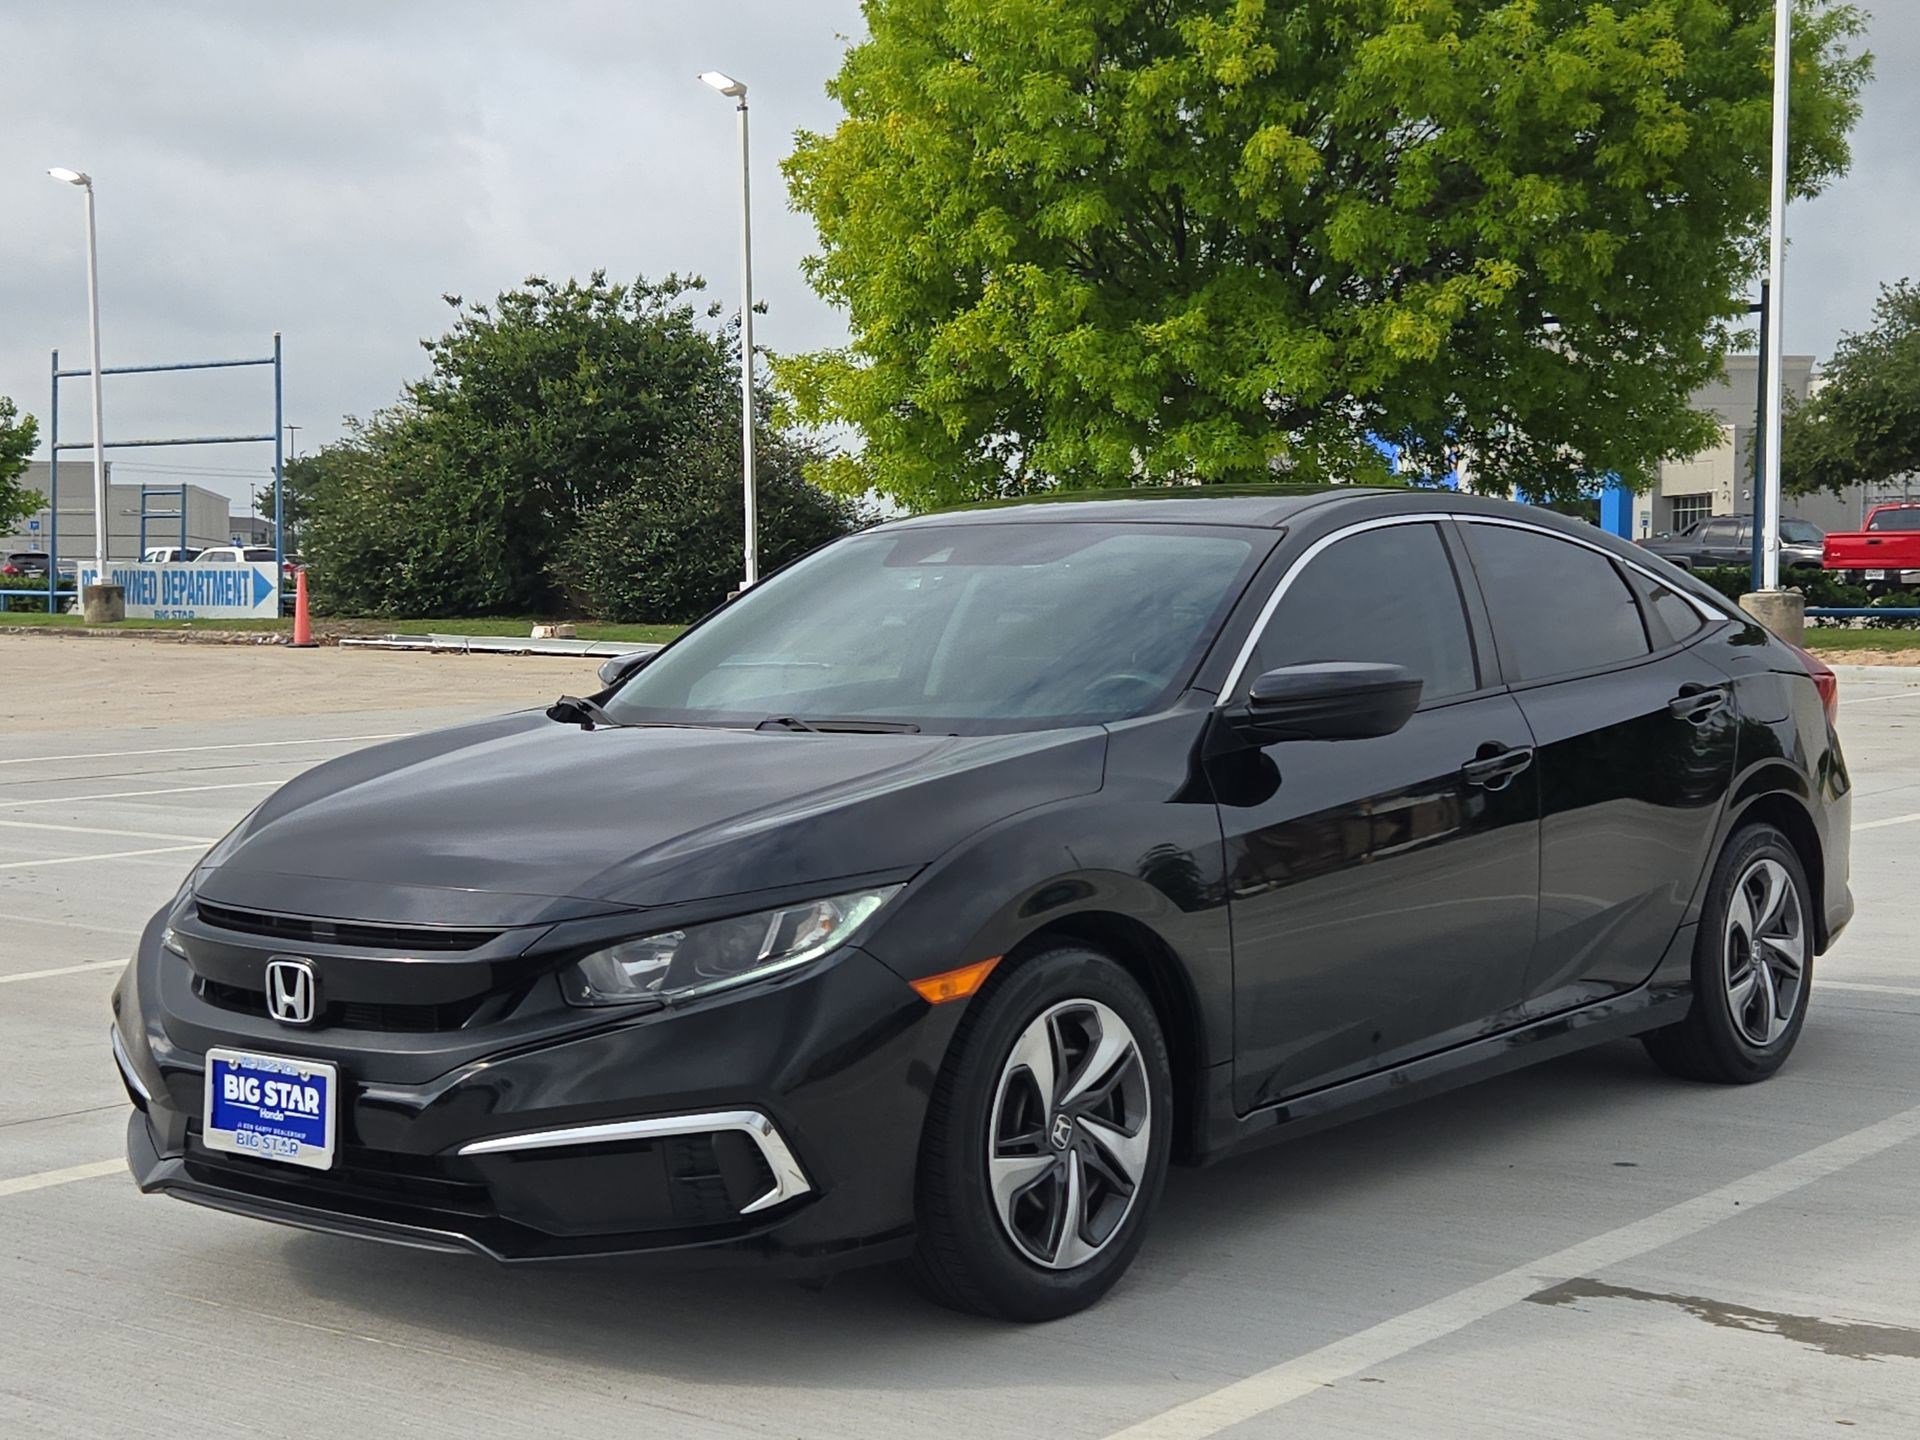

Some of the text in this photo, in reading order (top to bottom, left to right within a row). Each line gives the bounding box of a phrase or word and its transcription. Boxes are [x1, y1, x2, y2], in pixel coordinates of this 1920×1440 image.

[162, 569, 249, 606] DEPARTMENT
[172, 610, 195, 620] STAR
[224, 1074, 320, 1115] BIG STAR
[260, 1107, 285, 1122] Honda
[236, 1132, 299, 1154] BIG STAR
